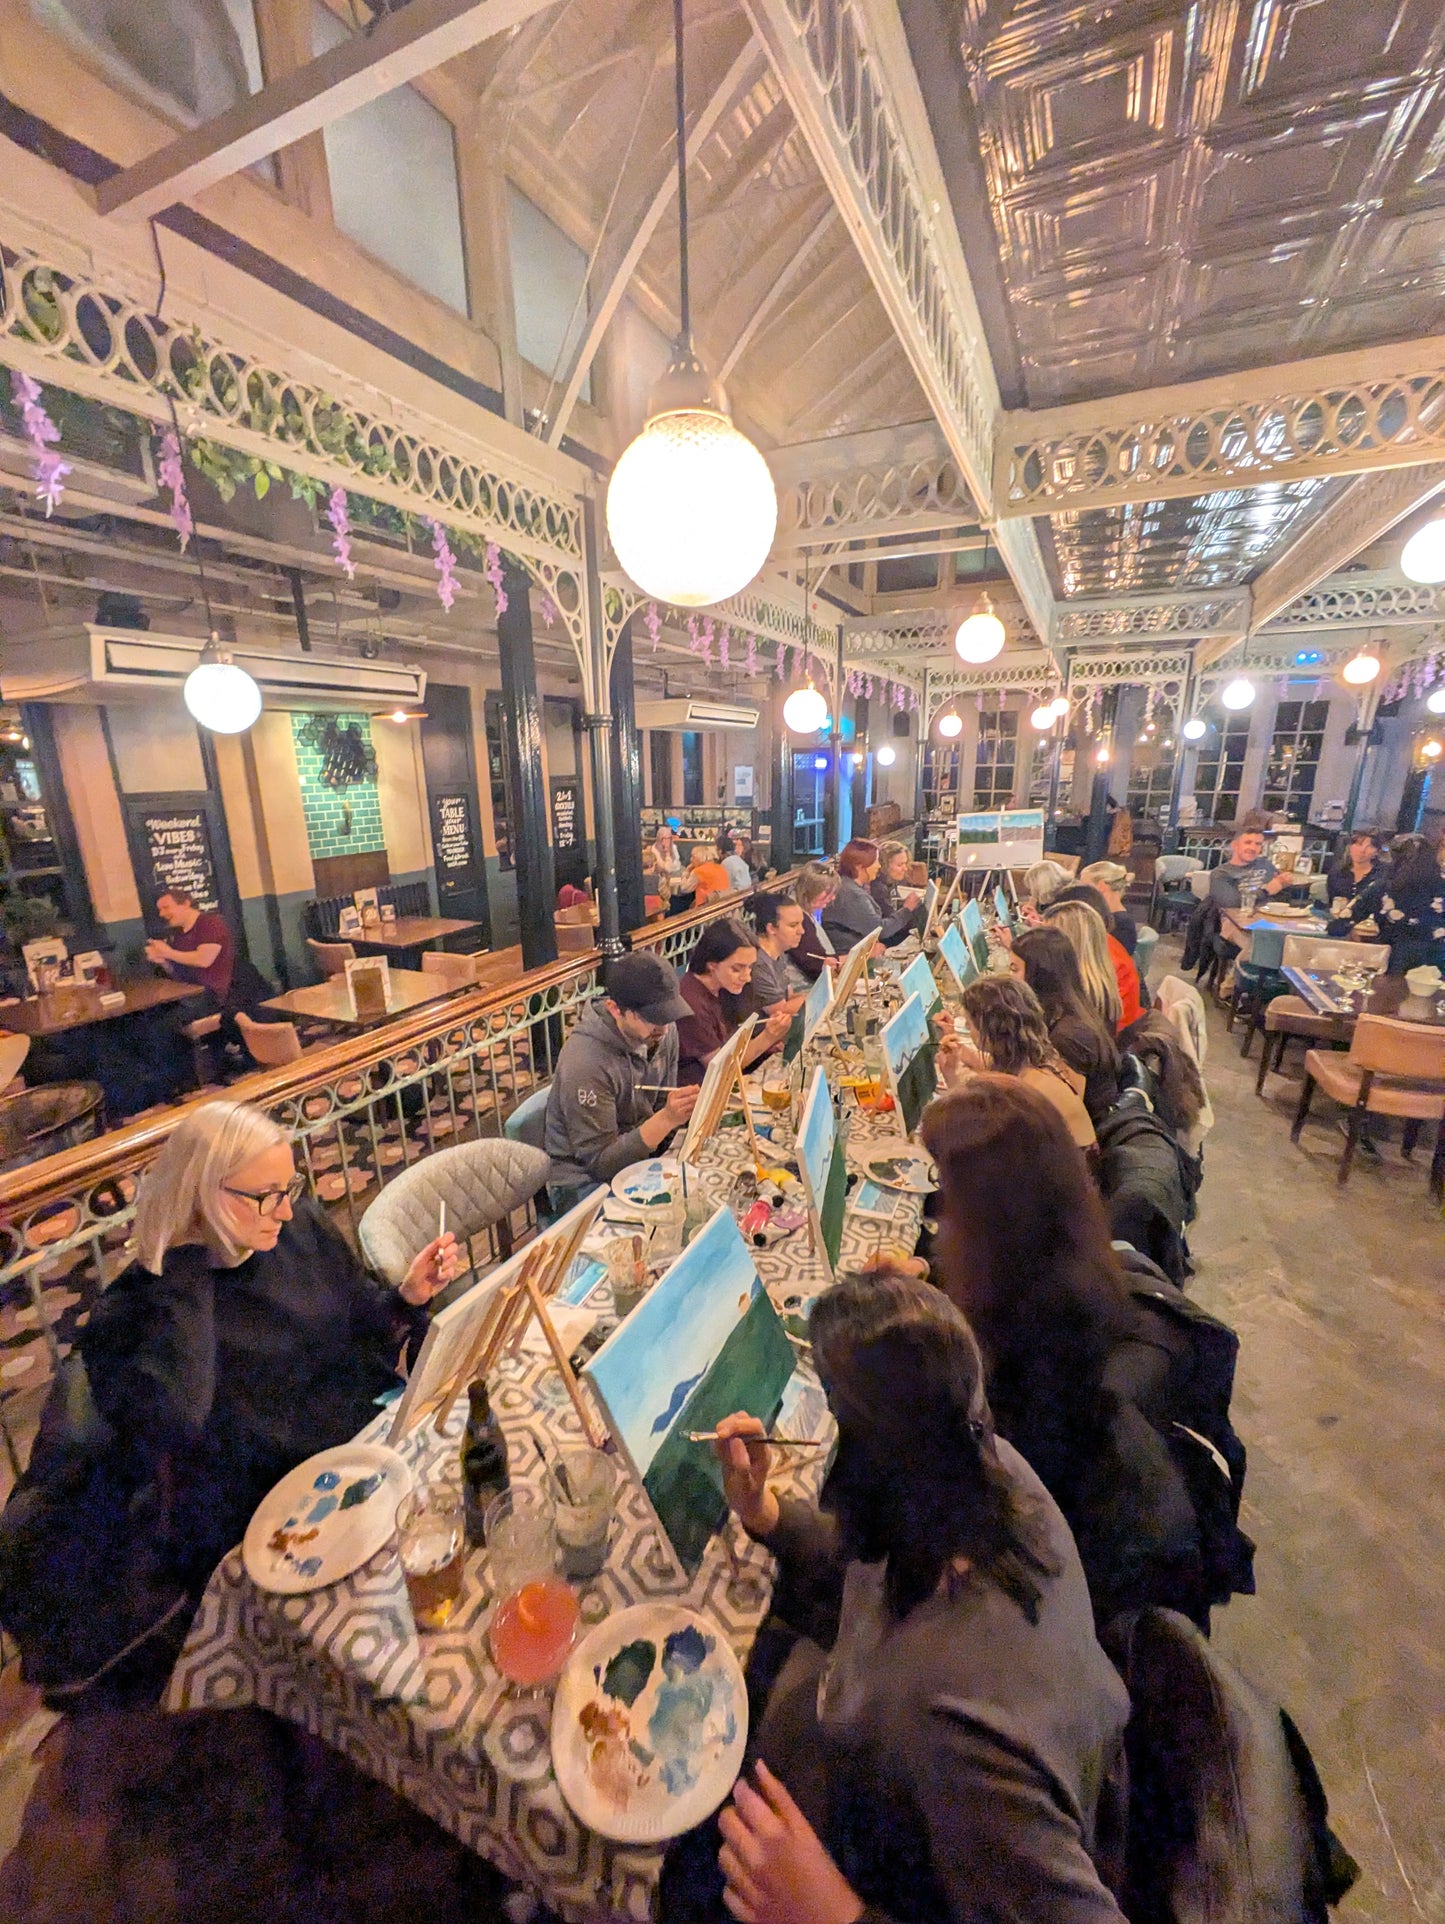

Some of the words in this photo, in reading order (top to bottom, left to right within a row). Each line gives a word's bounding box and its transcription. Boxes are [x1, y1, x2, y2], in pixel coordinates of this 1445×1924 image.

[440, 807, 465, 819] TABLE
[145, 815, 201, 830] Weekend
[443, 824, 465, 836] MENU
[153, 830, 196, 845] VIBES
